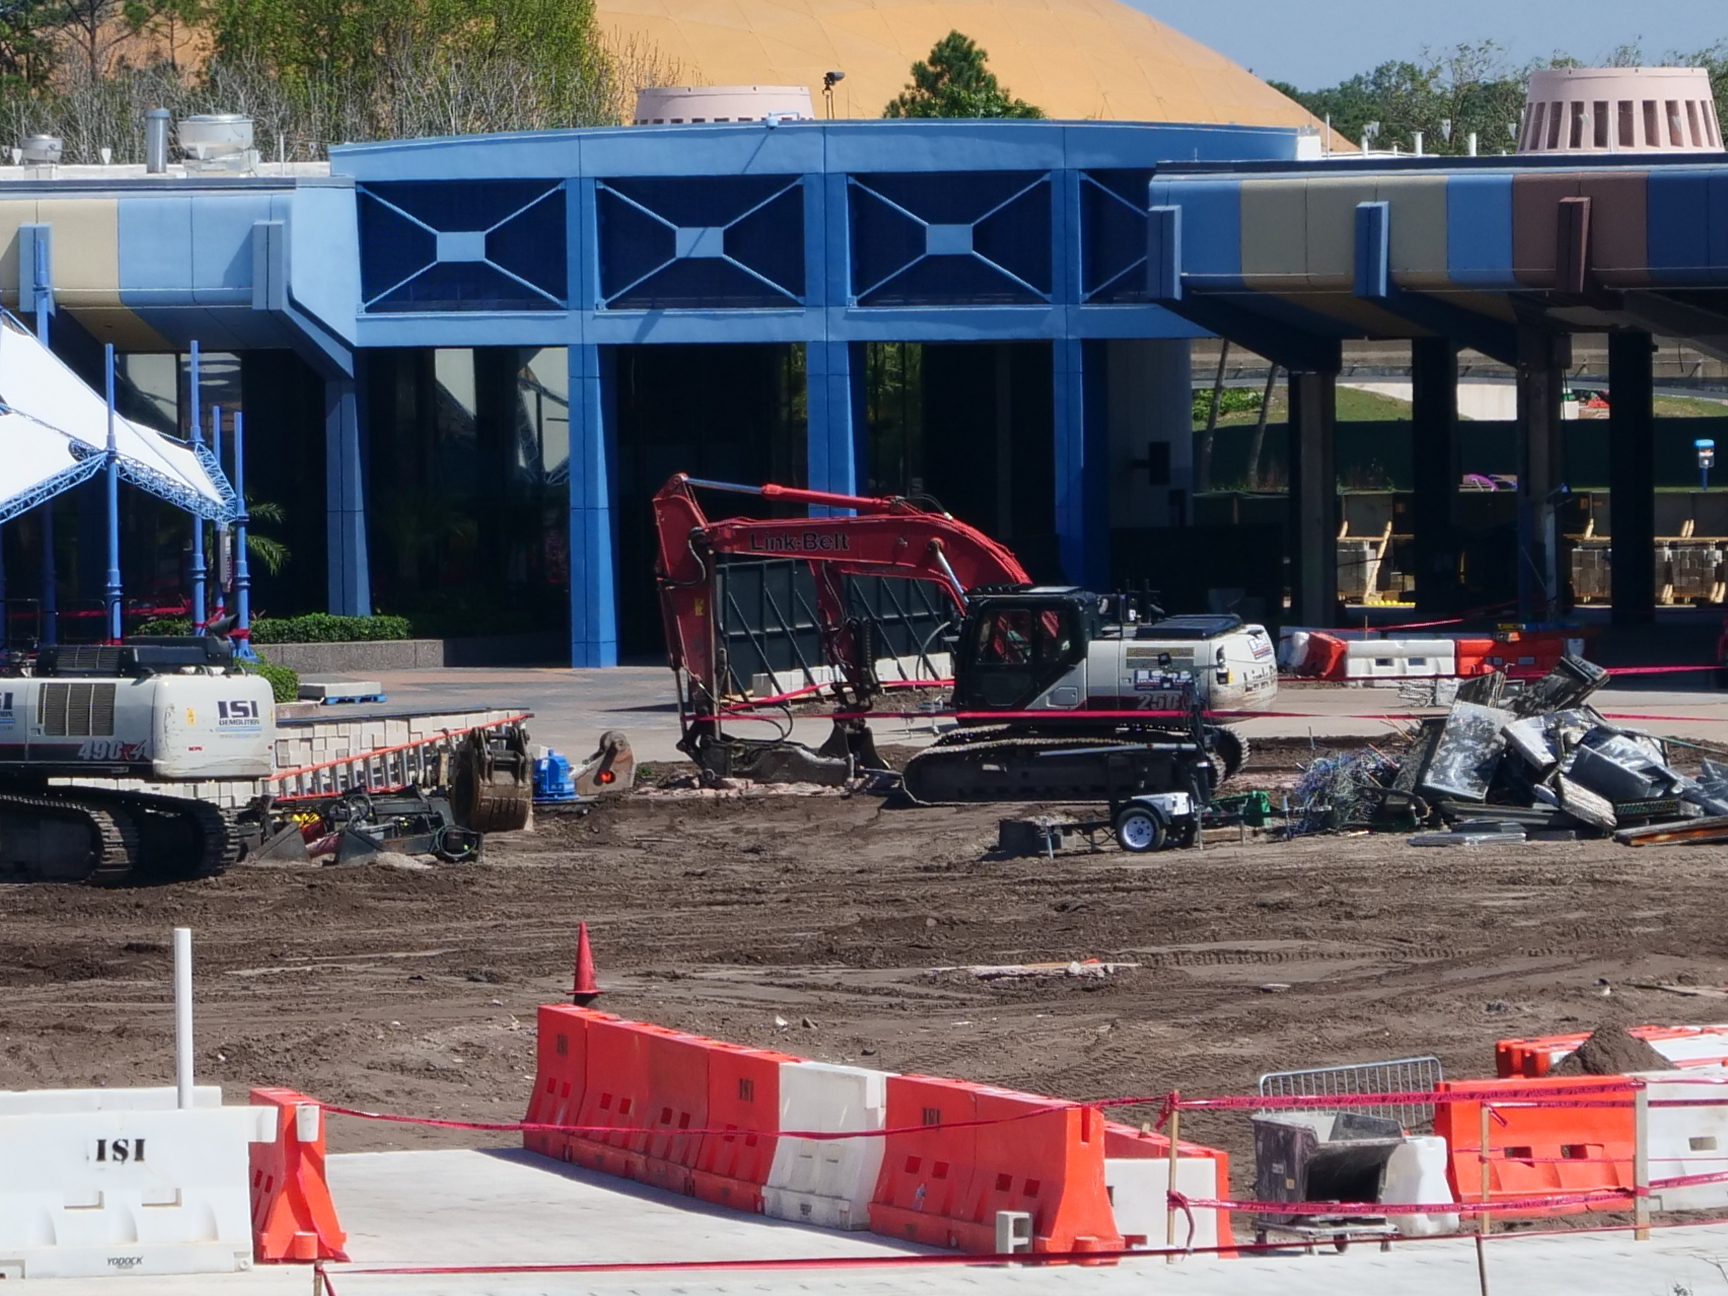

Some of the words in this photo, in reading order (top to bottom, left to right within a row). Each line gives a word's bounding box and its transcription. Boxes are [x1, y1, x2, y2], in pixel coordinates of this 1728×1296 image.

[750, 532, 850, 551] Link-Belt
[217, 700, 260, 718] ISI
[95, 1138, 146, 1162] ISI
[106, 1256, 144, 1266] YODOCK
